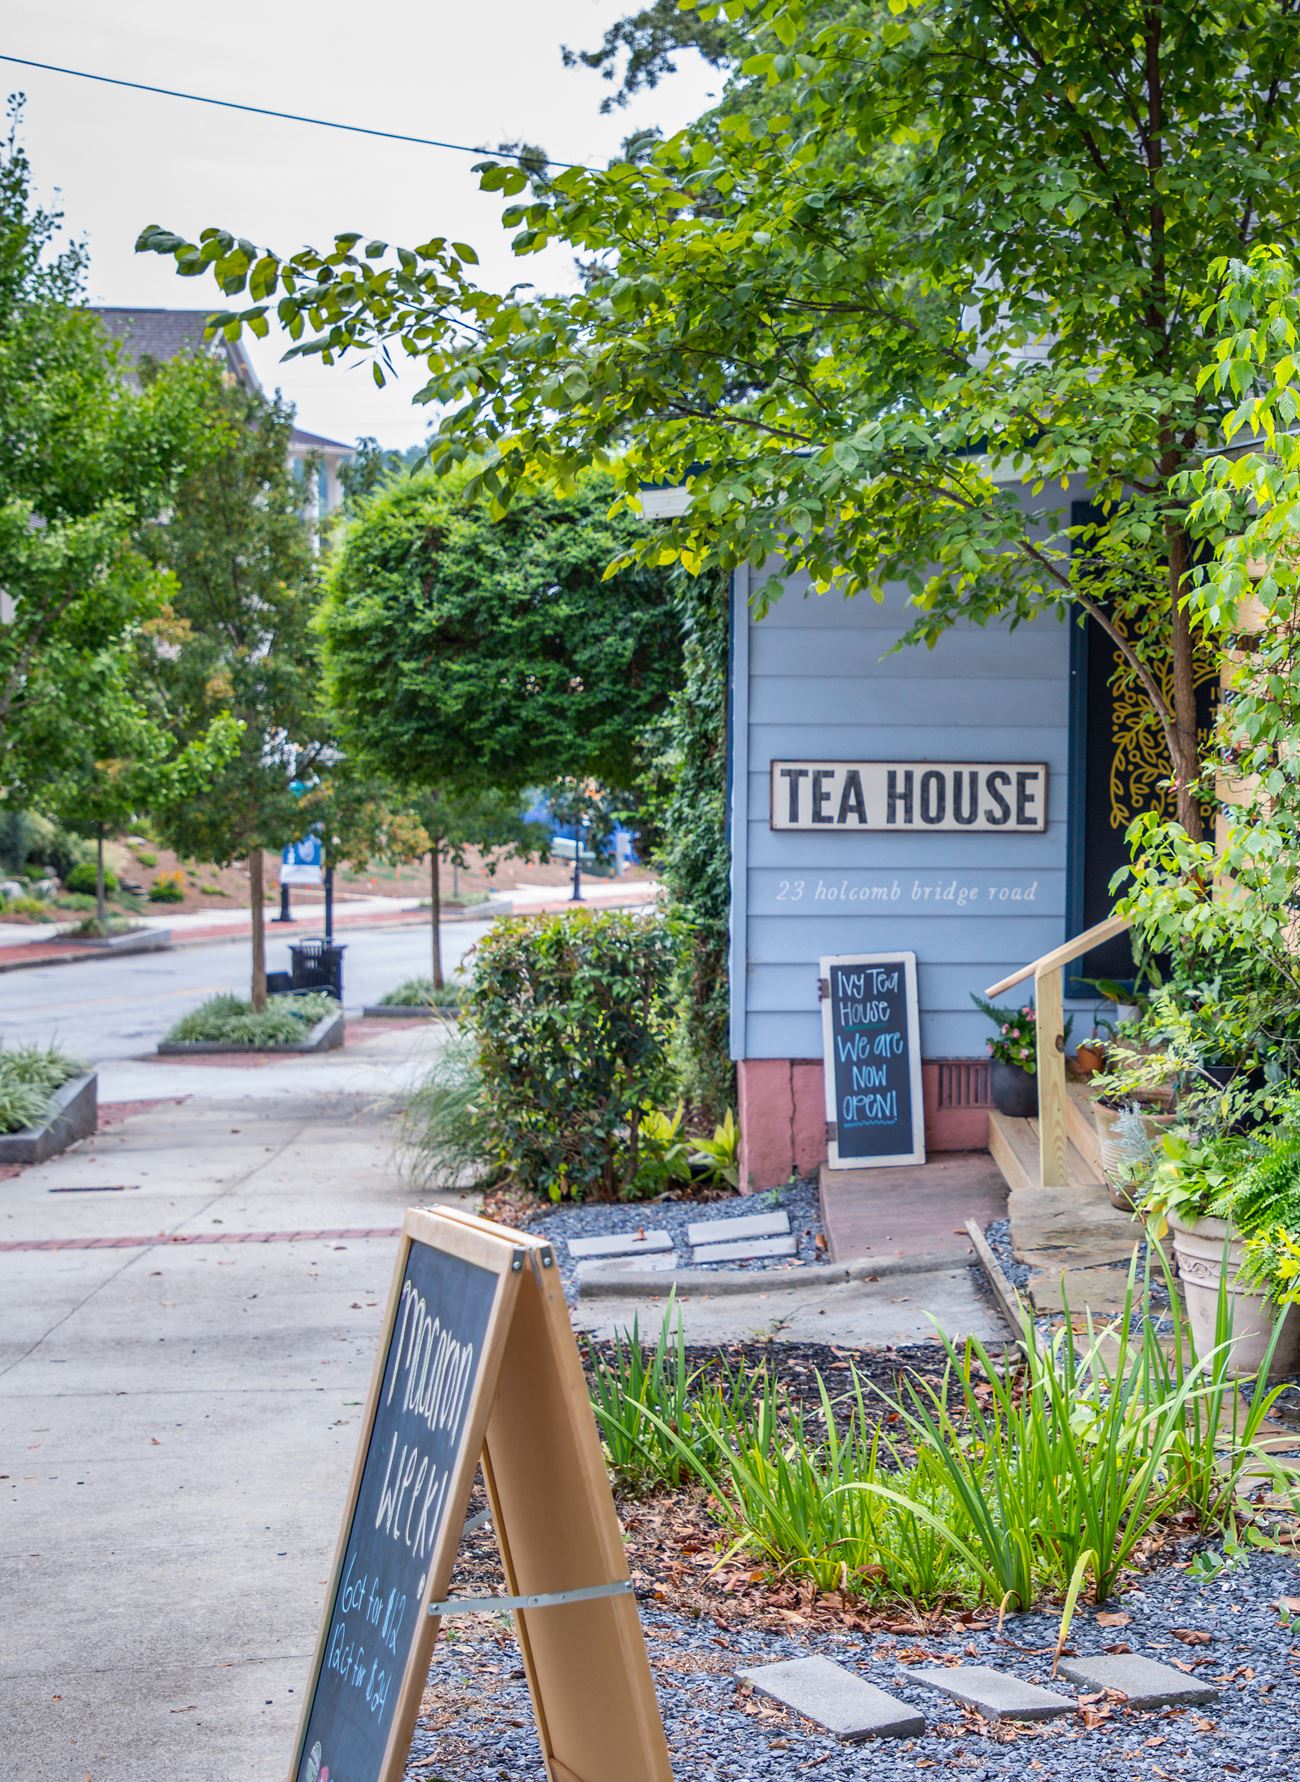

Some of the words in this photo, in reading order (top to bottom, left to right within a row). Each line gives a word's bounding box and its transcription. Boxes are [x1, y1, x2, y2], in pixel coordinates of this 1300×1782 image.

[780, 768, 868, 824] TEA
[886, 769, 1039, 825] HOUSE
[777, 880, 805, 900] 23
[815, 880, 901, 900] holcomb
[911, 881, 979, 906] bridge
[988, 881, 1038, 901] road
[838, 971, 865, 999] Ivy
[865, 968, 899, 995] Tea
[837, 1032, 870, 1063] We
[873, 1031, 904, 1058] are
[386, 1279, 473, 1447] Macaron
[341, 1551, 368, 1614] 6ct
[366, 1577, 384, 1627] for
